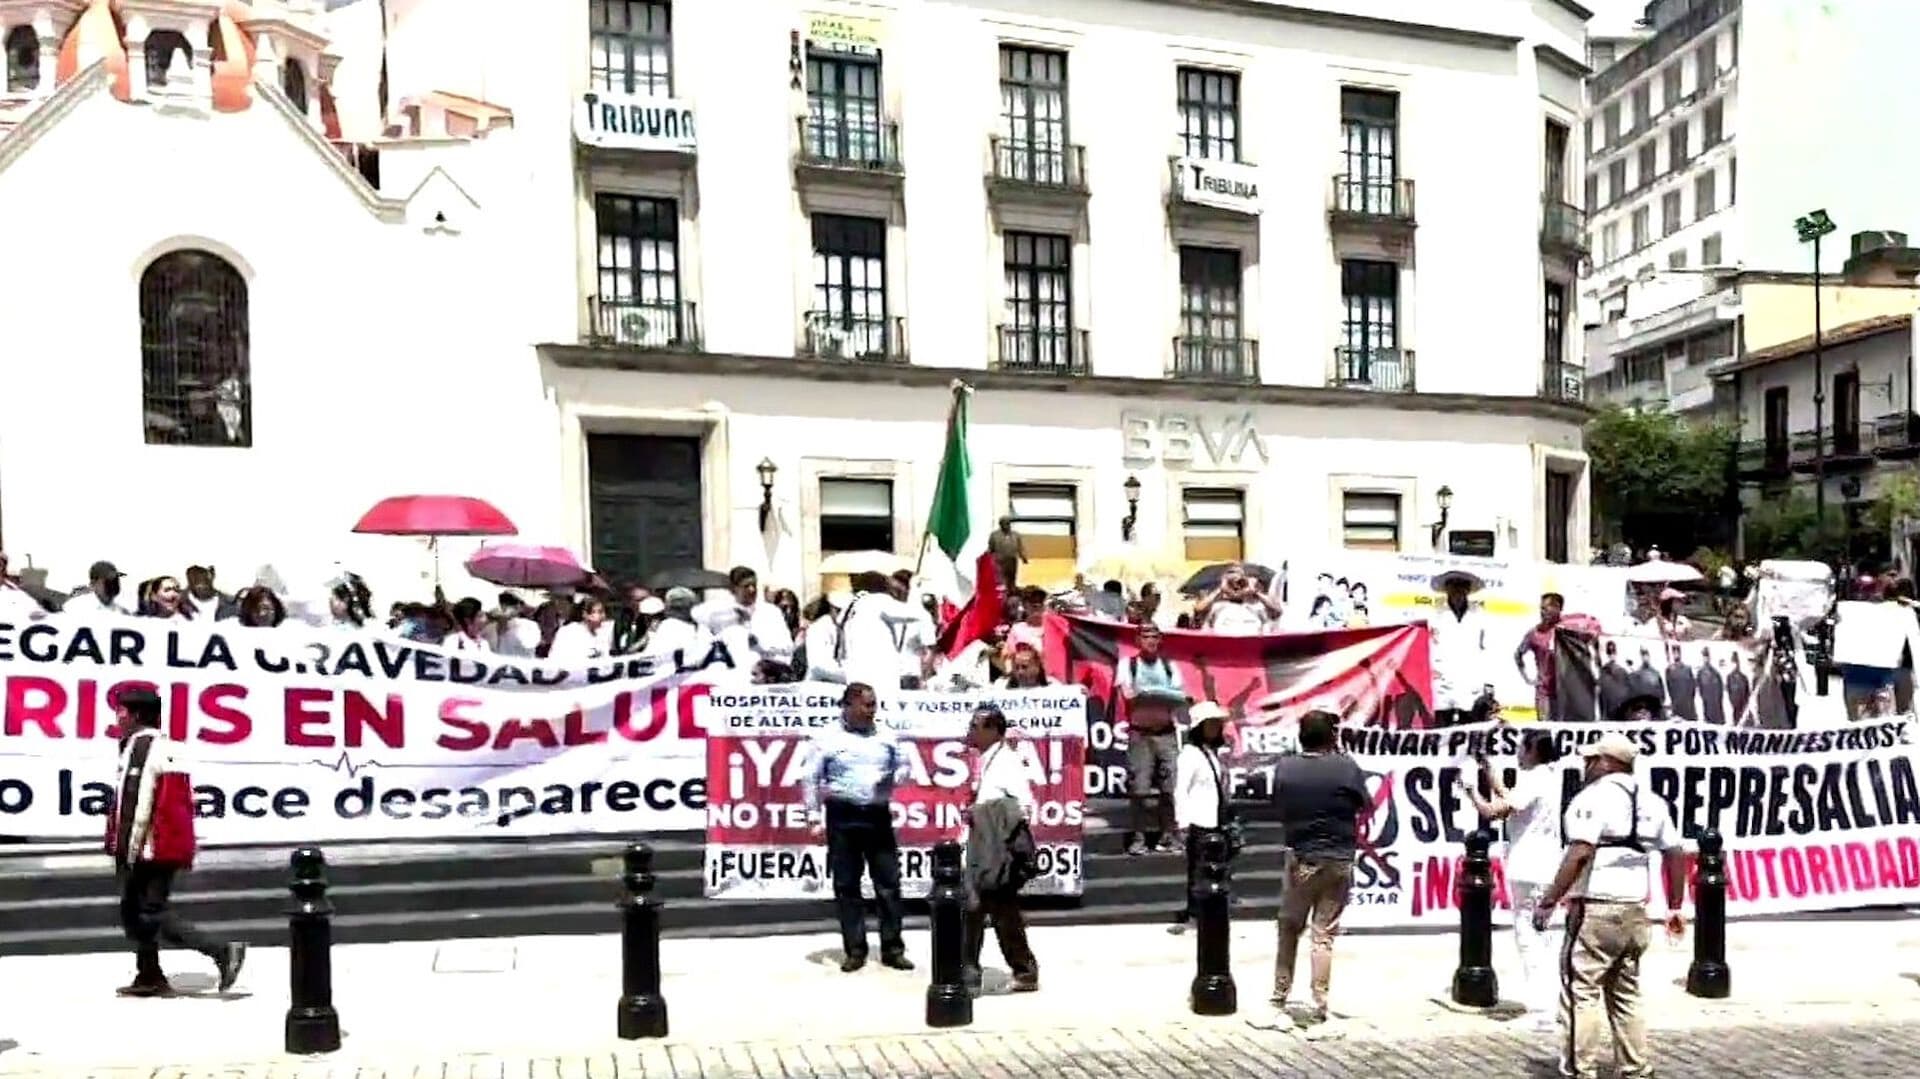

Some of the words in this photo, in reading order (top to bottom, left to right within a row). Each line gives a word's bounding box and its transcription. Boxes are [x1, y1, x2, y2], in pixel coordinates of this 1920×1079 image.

[1121, 409, 1269, 469] BBVA
[166, 631, 238, 671] LA
[674, 640, 736, 674] LA
[284, 686, 405, 749] EN
[710, 695, 799, 708] HOSPITAL
[730, 715, 753, 727] DE
[759, 715, 805, 727] ALTA
[1666, 728, 1719, 755] POR
[58, 769, 118, 816] la
[193, 785, 310, 819] ace
[707, 802, 759, 829] NO
[712, 851, 818, 887] ¡FUERA
